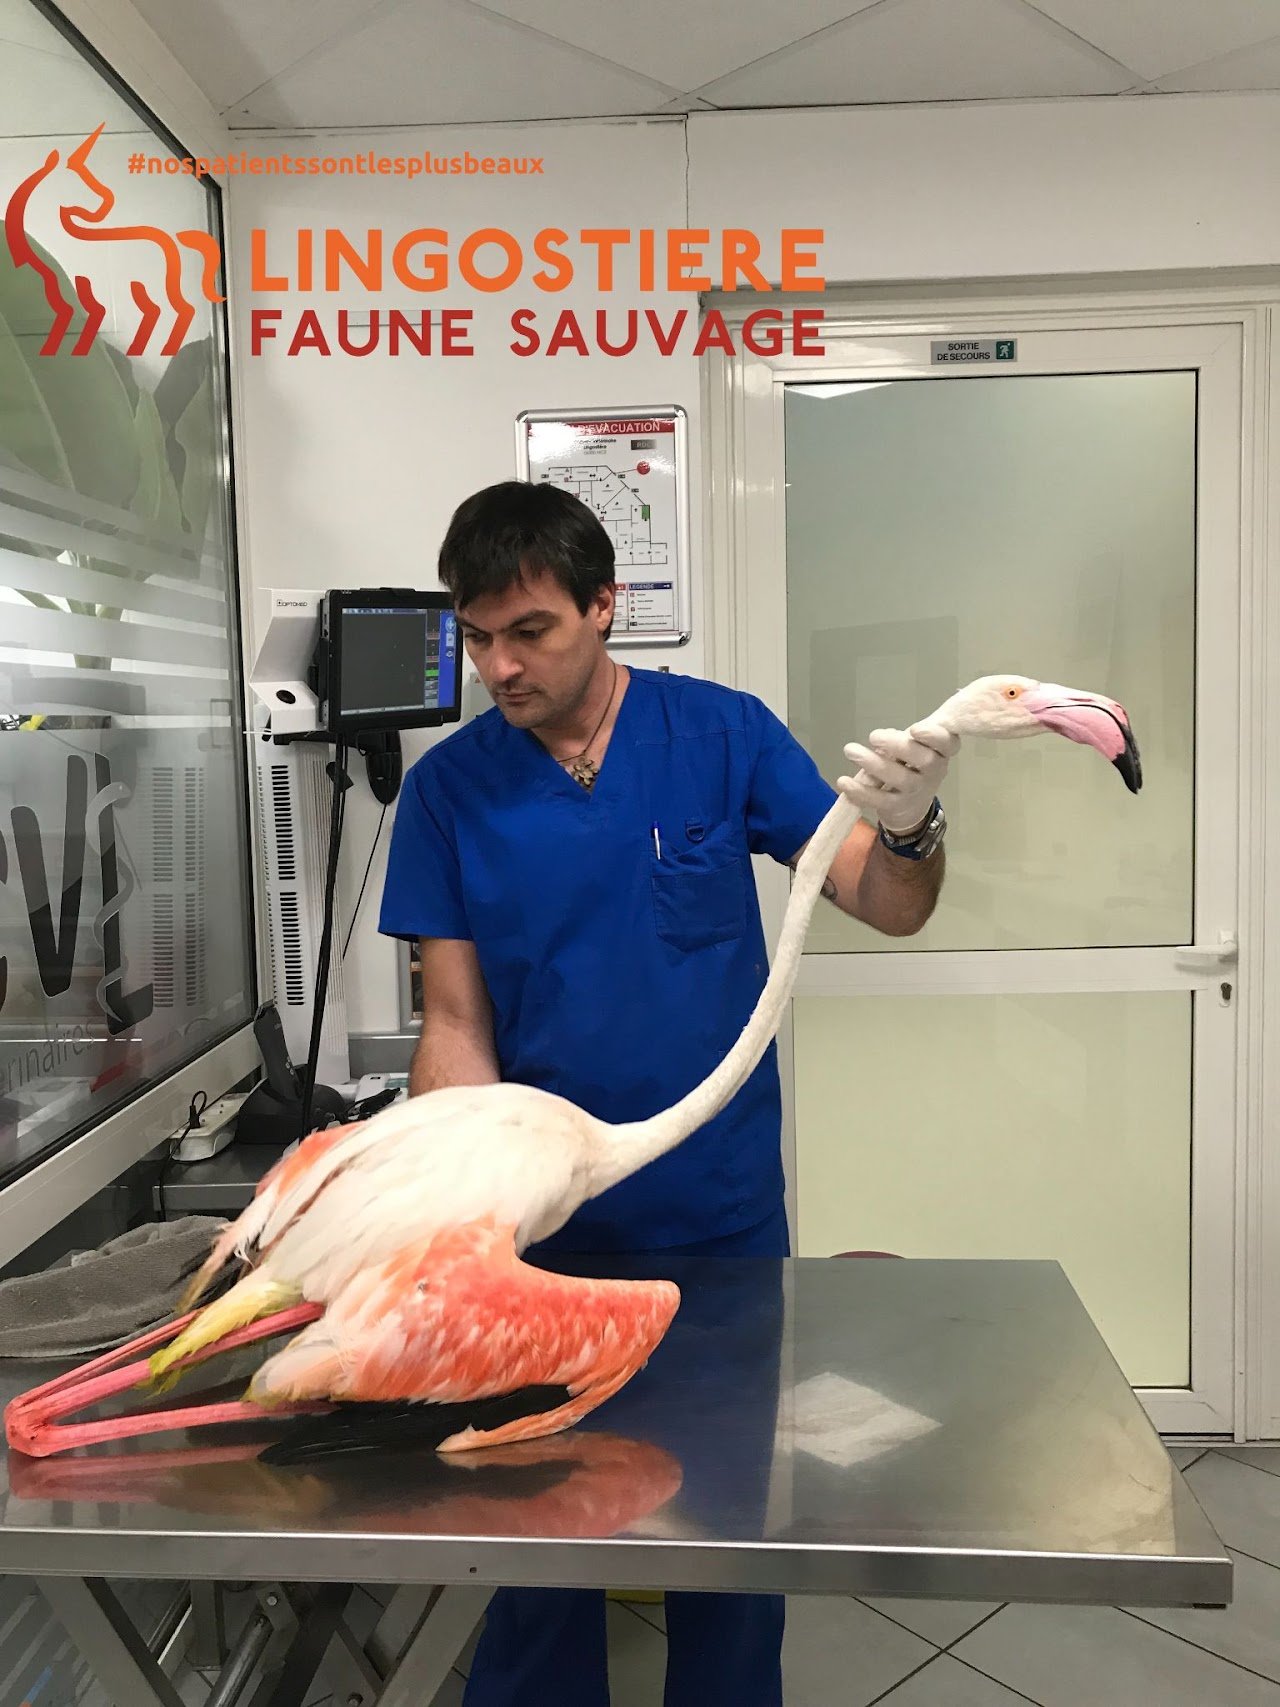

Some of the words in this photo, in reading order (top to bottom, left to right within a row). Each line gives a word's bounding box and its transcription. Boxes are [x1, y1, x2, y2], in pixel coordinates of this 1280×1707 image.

[947, 342, 980, 351] SORTIE
[937, 353, 949, 361] DE
[949, 351, 991, 361] SECOURS
